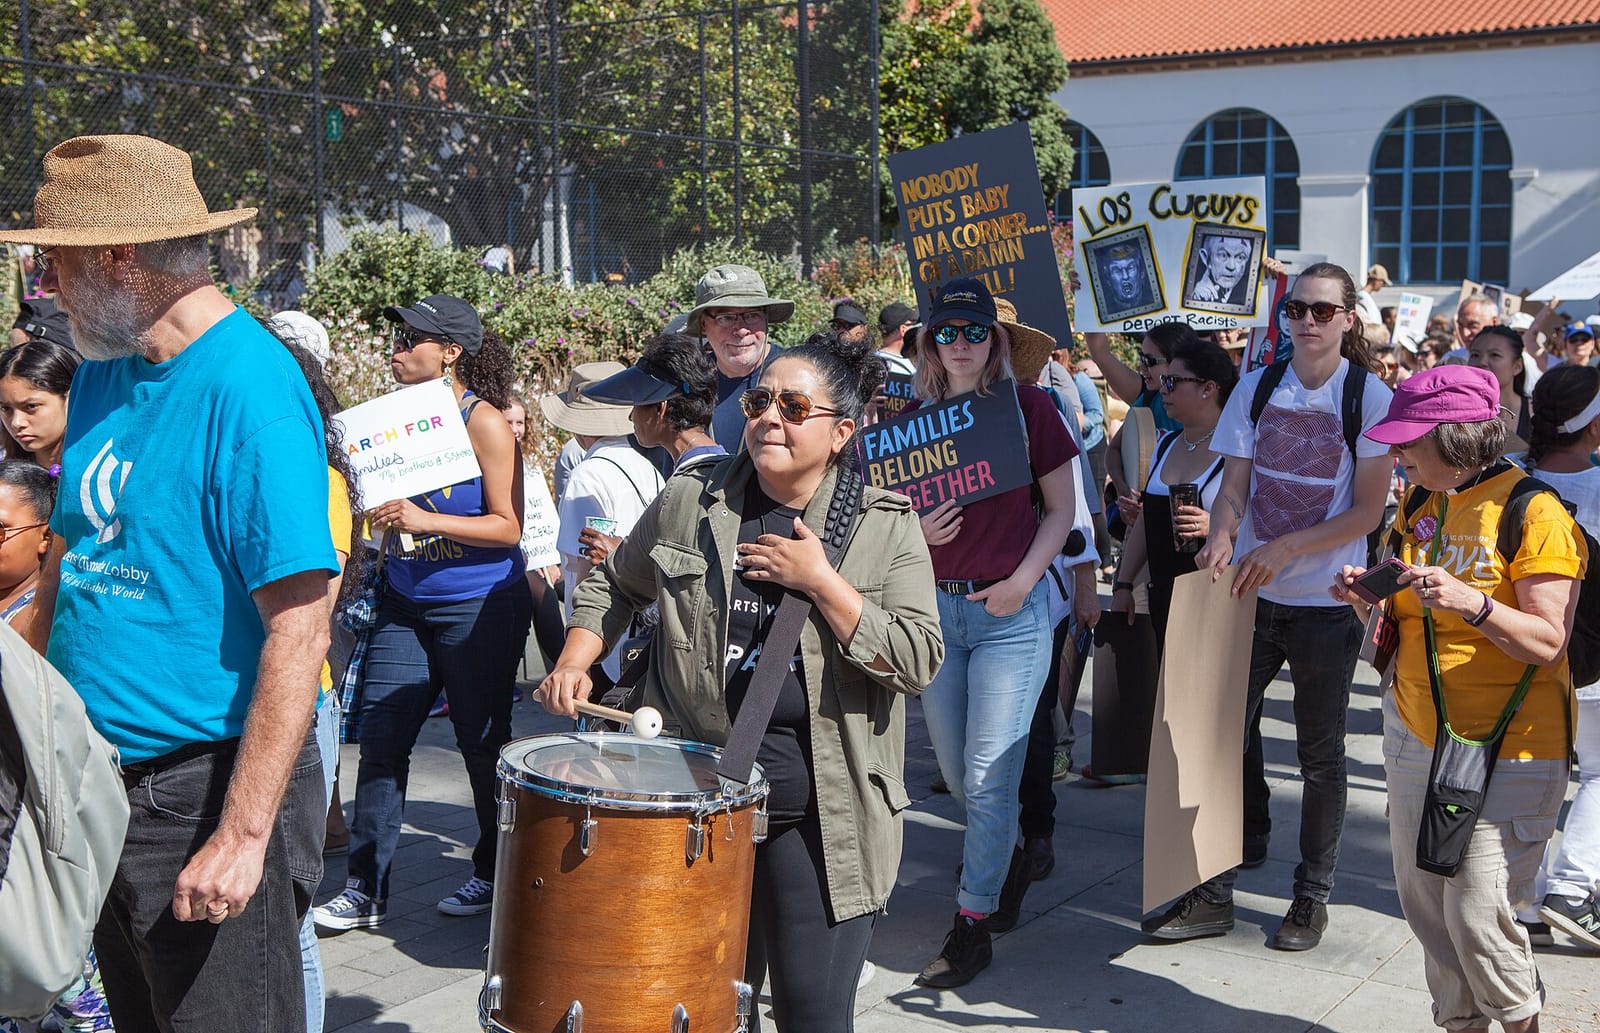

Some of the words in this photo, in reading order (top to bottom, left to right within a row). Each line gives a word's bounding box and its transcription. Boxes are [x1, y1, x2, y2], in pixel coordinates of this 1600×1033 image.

[901, 163, 979, 204] NOBODY
[906, 198, 956, 232] PUTS
[960, 184, 1009, 219] BABY
[1079, 191, 1133, 237] LOS
[912, 234, 935, 260] IN
[937, 231, 951, 254] A
[919, 259, 942, 284] OF
[947, 252, 962, 276] A
[962, 237, 1025, 273] DAMN
[1186, 313, 1238, 328] Racists
[883, 380, 900, 396] LAS
[349, 427, 399, 456] ARCH
[405, 416, 443, 436] FOR
[863, 400, 975, 461] FAMILIES
[352, 453, 404, 476] milies
[868, 439, 959, 489] BELONG
[888, 460, 996, 512] GETHER
[104, 561, 149, 584] Lobby
[1416, 542, 1494, 578] LOVE
[112, 585, 146, 600] World
[729, 600, 759, 613] RTS
